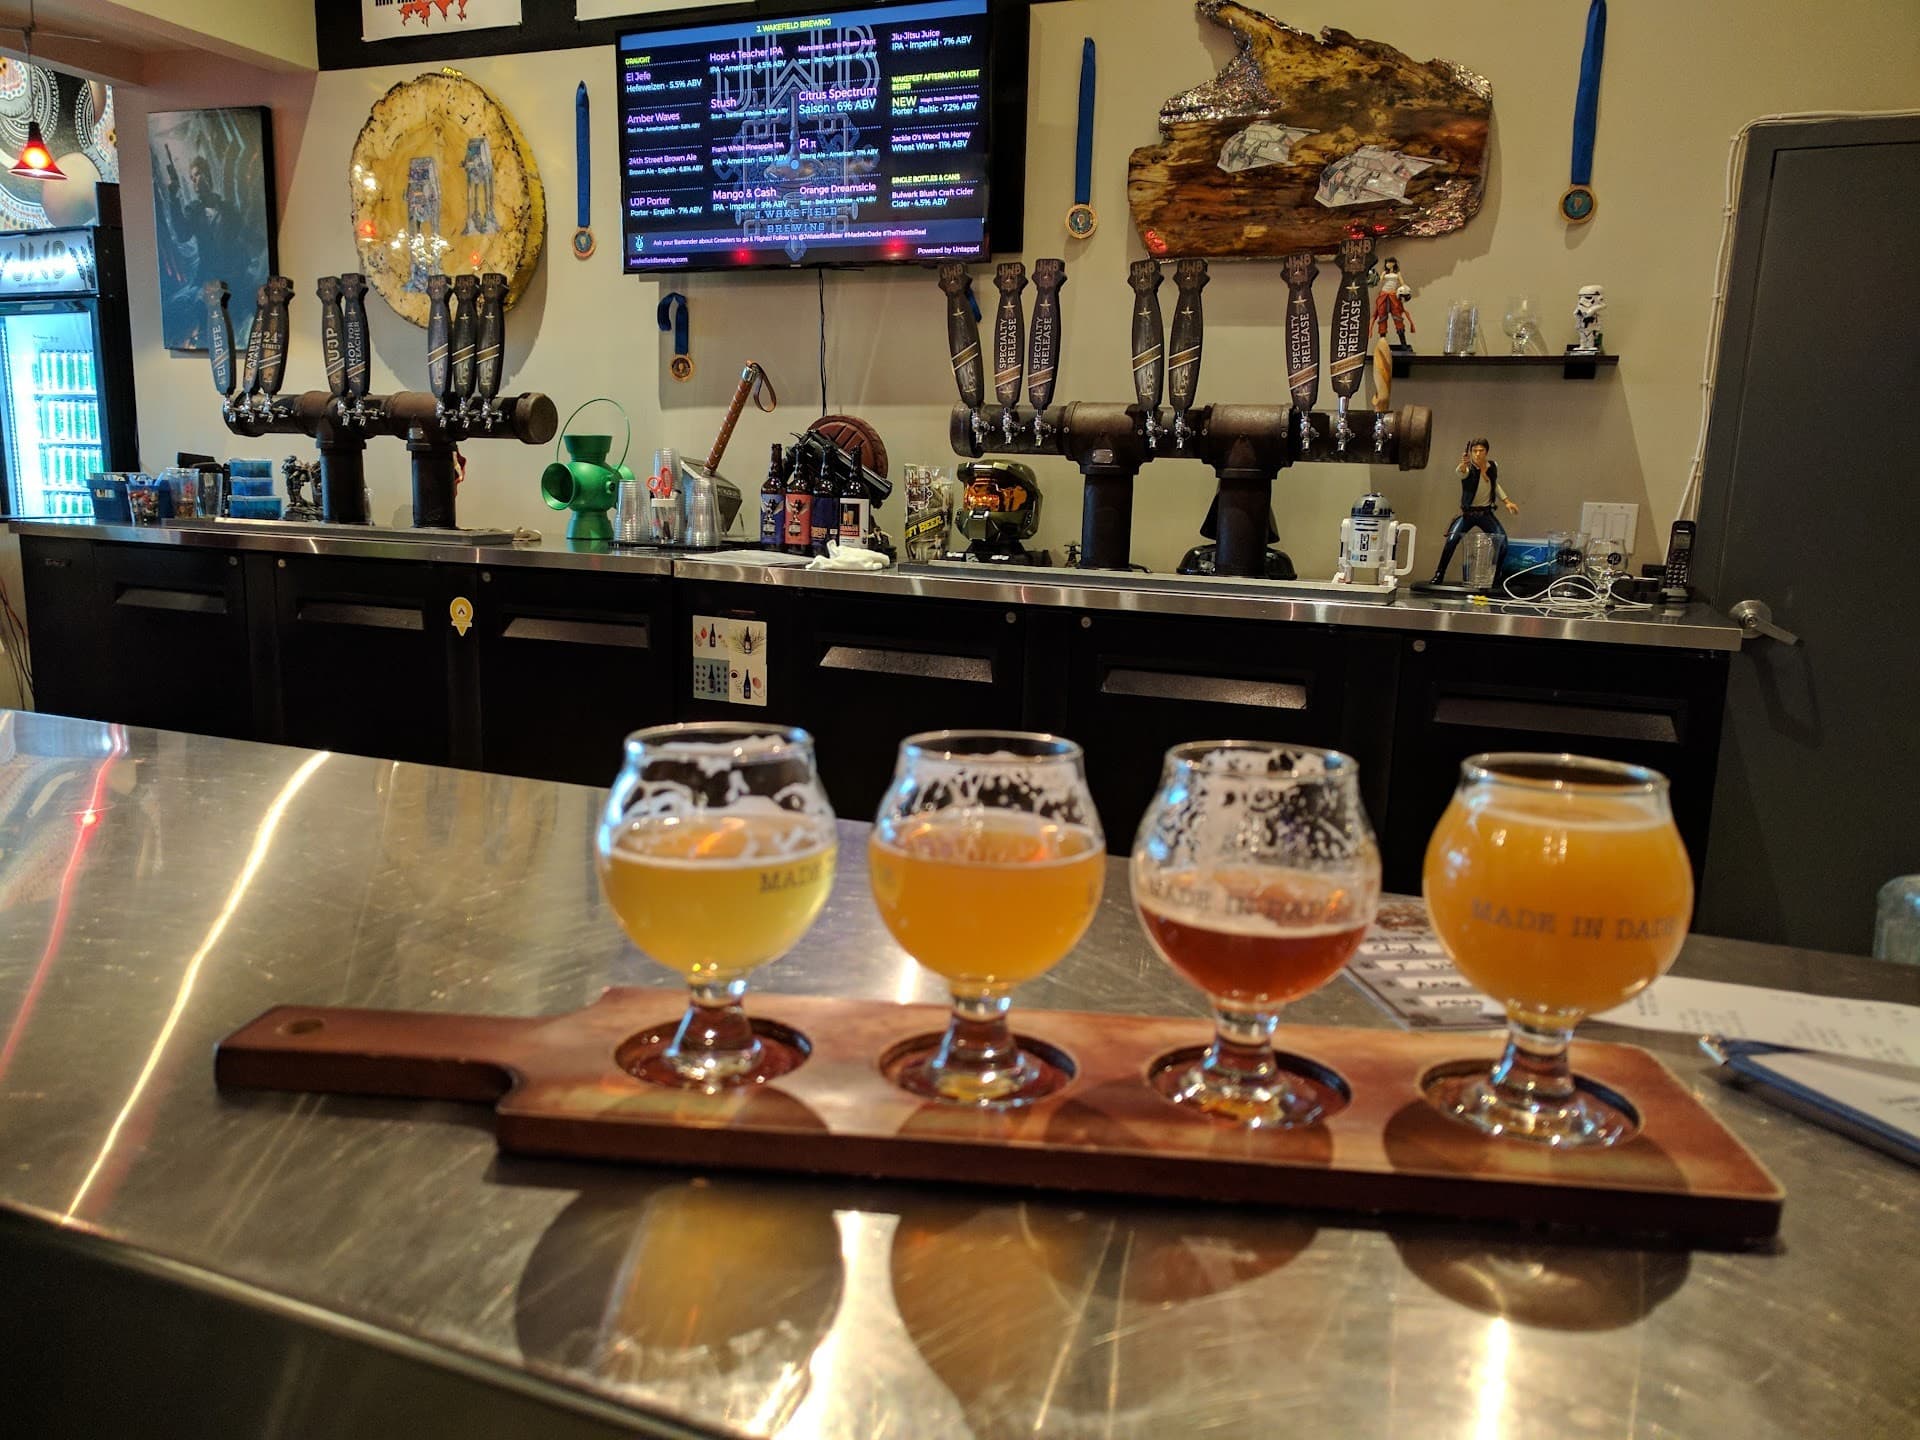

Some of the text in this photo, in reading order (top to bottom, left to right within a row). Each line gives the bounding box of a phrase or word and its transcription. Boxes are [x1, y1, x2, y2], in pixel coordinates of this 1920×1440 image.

[763, 22, 798, 32] WAKEFIELD
[800, 18, 832, 28] BREWING
[921, 30, 940, 38] Juice
[842, 40, 860, 48] Power
[861, 38, 876, 46] Plant
[892, 42, 904, 50] IPA
[910, 38, 939, 49] Imperial
[956, 35, 972, 44] ABV
[710, 46, 784, 62] Hops 4 Teacher IPA
[710, 66, 720, 74] IPA
[724, 63, 753, 72] American
[773, 60, 786, 68] ABV
[626, 72, 634, 82] El
[924, 71, 959, 81] AFTERMATH
[960, 69, 980, 78] GUEST
[626, 78, 702, 94] Hefeweizen 5.5% ABV
[799, 86, 878, 100] Citrus Spectrum
[710, 96, 736, 108] Stush
[799, 98, 877, 115] Saison 6% ABV
[892, 96, 918, 107] NEW
[892, 108, 914, 116] Porter
[918, 104, 939, 113] Baltic
[960, 102, 977, 110] ABV
[628, 112, 680, 124] Amber Waves
[922, 132, 940, 140] Wood
[950, 131, 971, 140] Honey
[800, 138, 808, 149] Pi
[892, 143, 916, 152] Wheat
[916, 142, 934, 150] Wine
[952, 140, 968, 148] ABV
[644, 156, 663, 164] Street
[686, 153, 697, 161] Ale
[912, 174, 938, 182] BOTTLES
[944, 172, 960, 180] CANS
[713, 187, 776, 200] Mango & Cash
[800, 182, 876, 196] Orange Dreamsicle
[919, 189, 938, 197] Blush
[938, 188, 954, 196] Craft
[956, 188, 974, 196] Cider
[646, 196, 670, 206] Porter
[730, 201, 756, 212] Imperial
[772, 200, 788, 208] ABV
[892, 200, 910, 208] Cider
[932, 198, 948, 206] ABV
[653, 208, 675, 216] English
[689, 206, 702, 214] ABV
[767, 222, 825, 233] BREWING
[918, 244, 980, 254] Powered by Untappd
[1338, 300, 1350, 358] SPECIALTY
[1349, 300, 1362, 352] RELEASE
[212, 325, 223, 358] JEFE
[326, 327, 340, 362] UJP
[354, 321, 362, 362] TEACHER
[1000, 318, 1008, 369] SPECIALTY
[1008, 318, 1016, 364] RELEASE
[1033, 316, 1043, 370] SPECIALTY
[1041, 318, 1052, 365] RELEASE
[1290, 315, 1301, 370] SPECIALTY
[1301, 313, 1310, 363] RELEASE
[348, 342, 356, 366] HOP
[1471, 897, 1557, 935] MADE
[1571, 914, 1605, 940] IN
